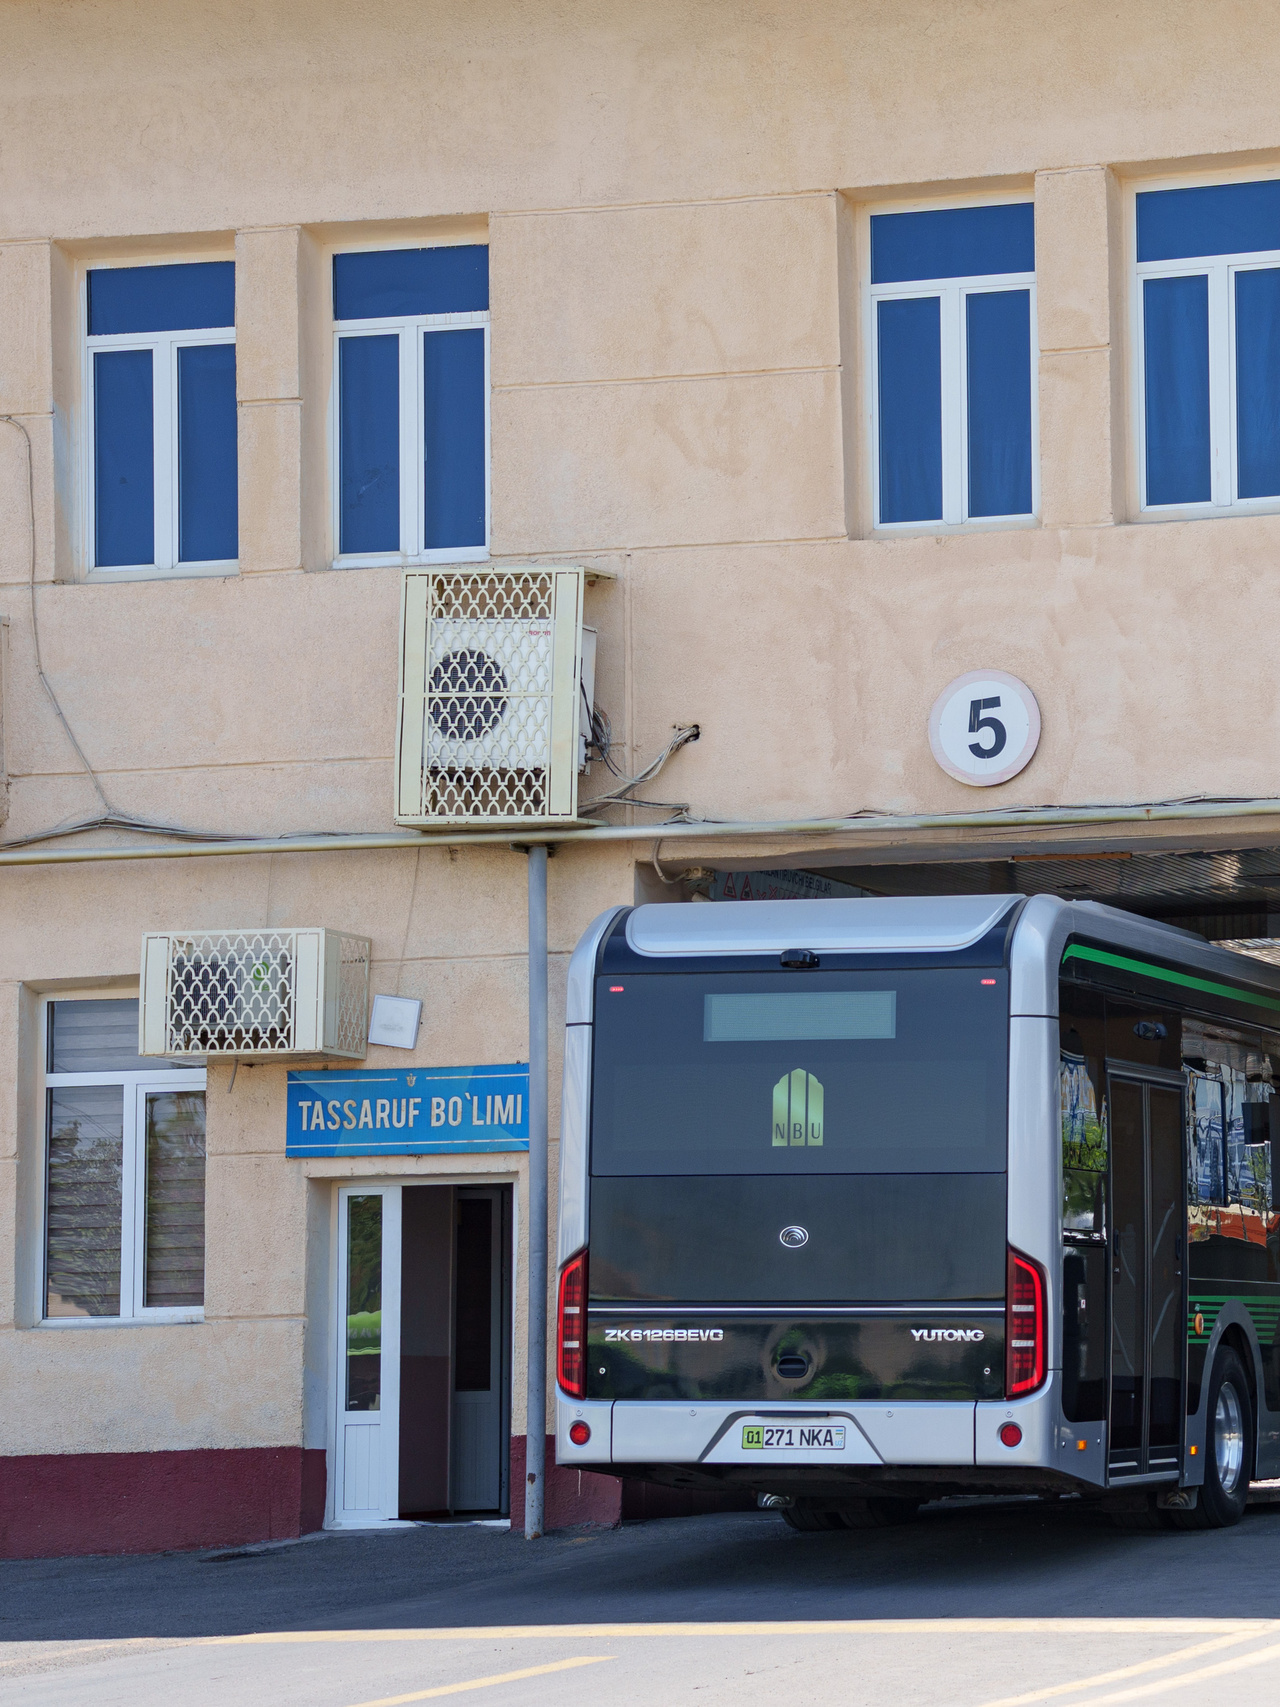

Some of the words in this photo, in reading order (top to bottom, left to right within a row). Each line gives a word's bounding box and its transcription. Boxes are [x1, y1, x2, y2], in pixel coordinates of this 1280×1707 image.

[968, 695, 1007, 760] 5
[298, 1097, 422, 1131] TASSARUF
[775, 1122, 821, 1140] NBU
[604, 1328, 725, 1343] ZK6126BEVG
[910, 1328, 986, 1343] YUTONG
[746, 1430, 762, 1444] 01
[764, 1428, 795, 1446] 271
[799, 1428, 834, 1447] NKA
